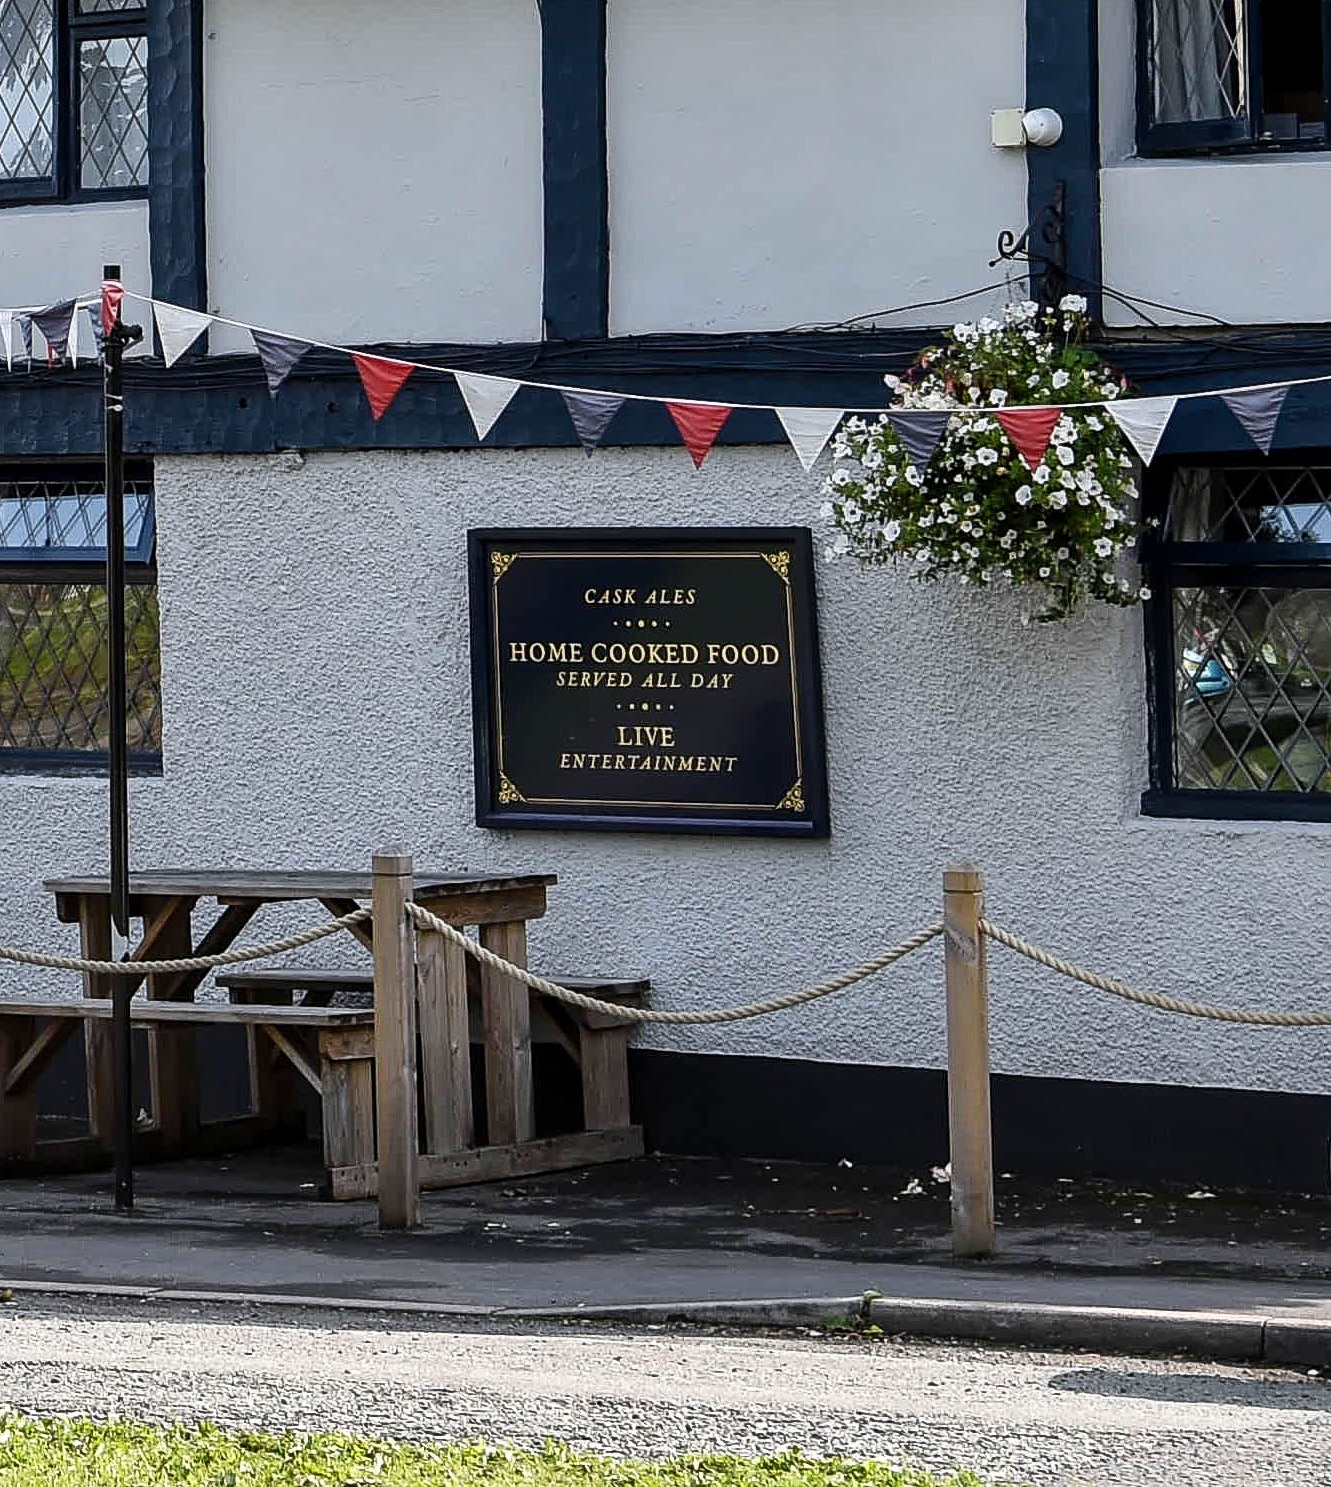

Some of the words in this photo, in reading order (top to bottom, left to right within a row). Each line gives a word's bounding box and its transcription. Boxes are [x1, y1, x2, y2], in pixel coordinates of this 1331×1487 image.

[584, 588, 637, 605] CASK
[644, 589, 697, 605] ALES
[508, 642, 584, 663] HOME
[591, 643, 699, 664] COOKED
[707, 644, 780, 665] FOOD
[556, 671, 633, 688] SERVED
[641, 672, 682, 688] ALL
[690, 673, 735, 689] DAY
[617, 726, 676, 747] LIVE
[559, 754, 738, 772] ENTERTAINMENT
